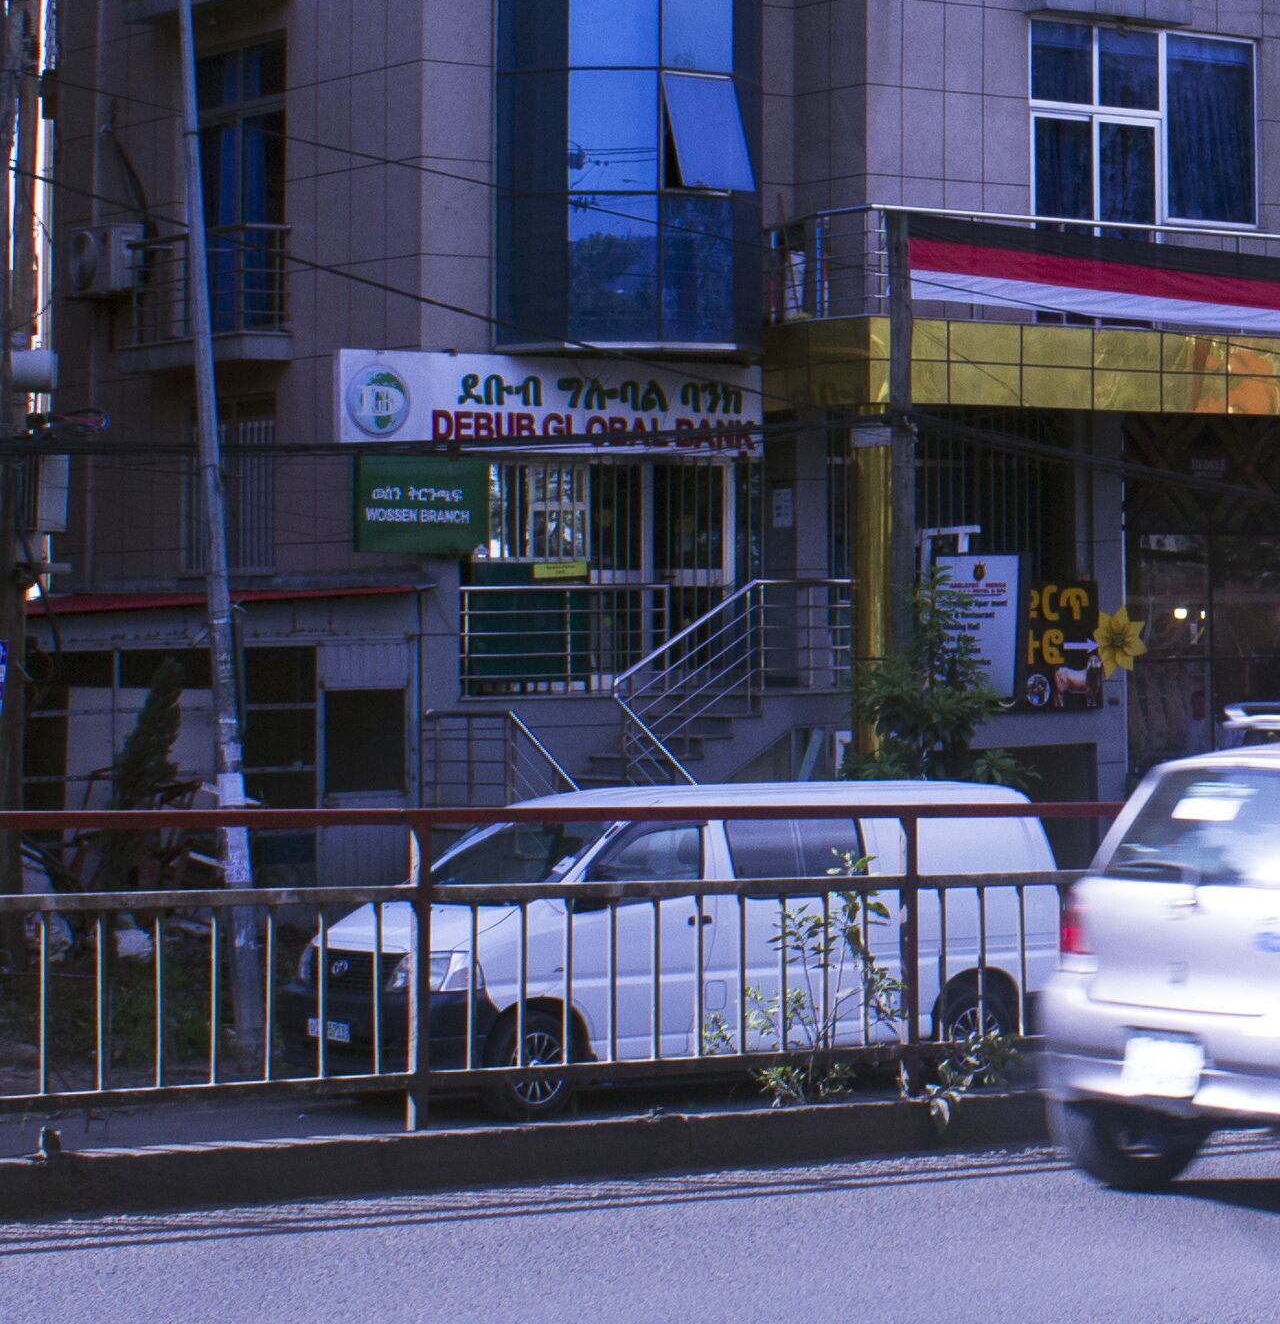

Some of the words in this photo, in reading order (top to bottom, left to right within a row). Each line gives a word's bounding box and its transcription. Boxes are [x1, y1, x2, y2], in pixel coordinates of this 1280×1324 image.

[457, 373, 544, 407] ደቡብ
[557, 376, 669, 412] ግሎባል
[680, 381, 743, 414] ባንክ
[432, 409, 537, 442] DEBUB
[542, 412, 668, 448] GLOBAL
[675, 418, 757, 452] BANK
[365, 507, 418, 523] WOSSEN
[420, 508, 470, 524] BRANCH
